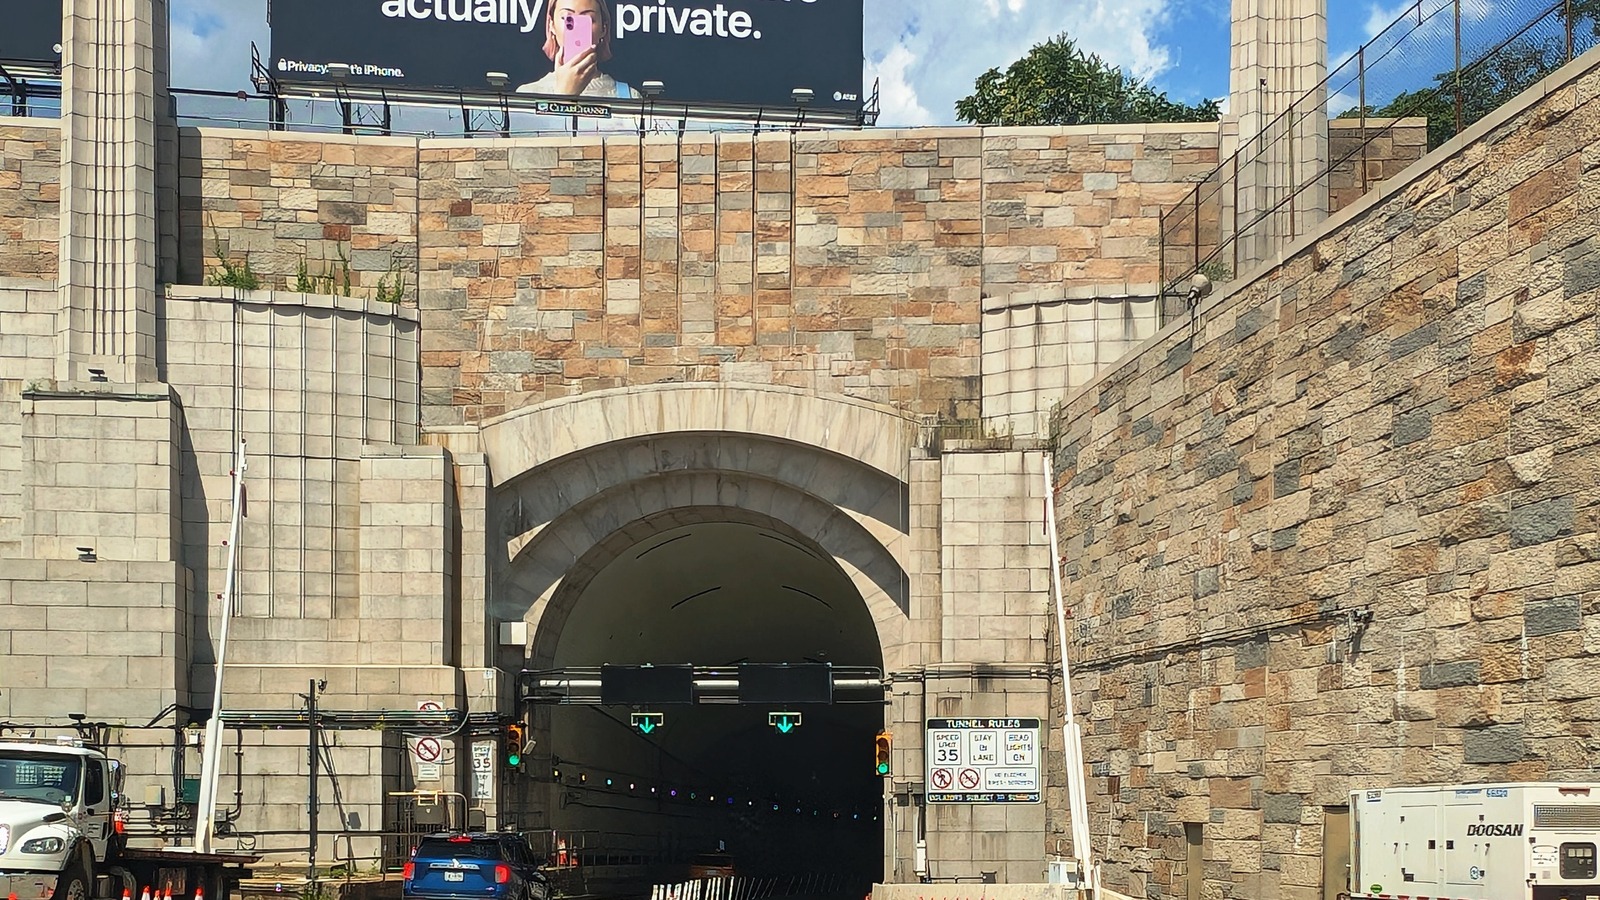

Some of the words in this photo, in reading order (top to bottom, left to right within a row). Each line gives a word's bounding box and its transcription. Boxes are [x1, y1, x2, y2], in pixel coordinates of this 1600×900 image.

[381, 0, 543, 33] actually
[616, 0, 762, 39] private.
[287, 60, 329, 75] Privacy.
[364, 65, 404, 77] iPhone.
[946, 720, 985, 728] TUNNEL
[988, 720, 1021, 728] RULES
[937, 749, 959, 761] 35
[473, 758, 491, 769] 35
[1466, 823, 1524, 837] DOOSAN
